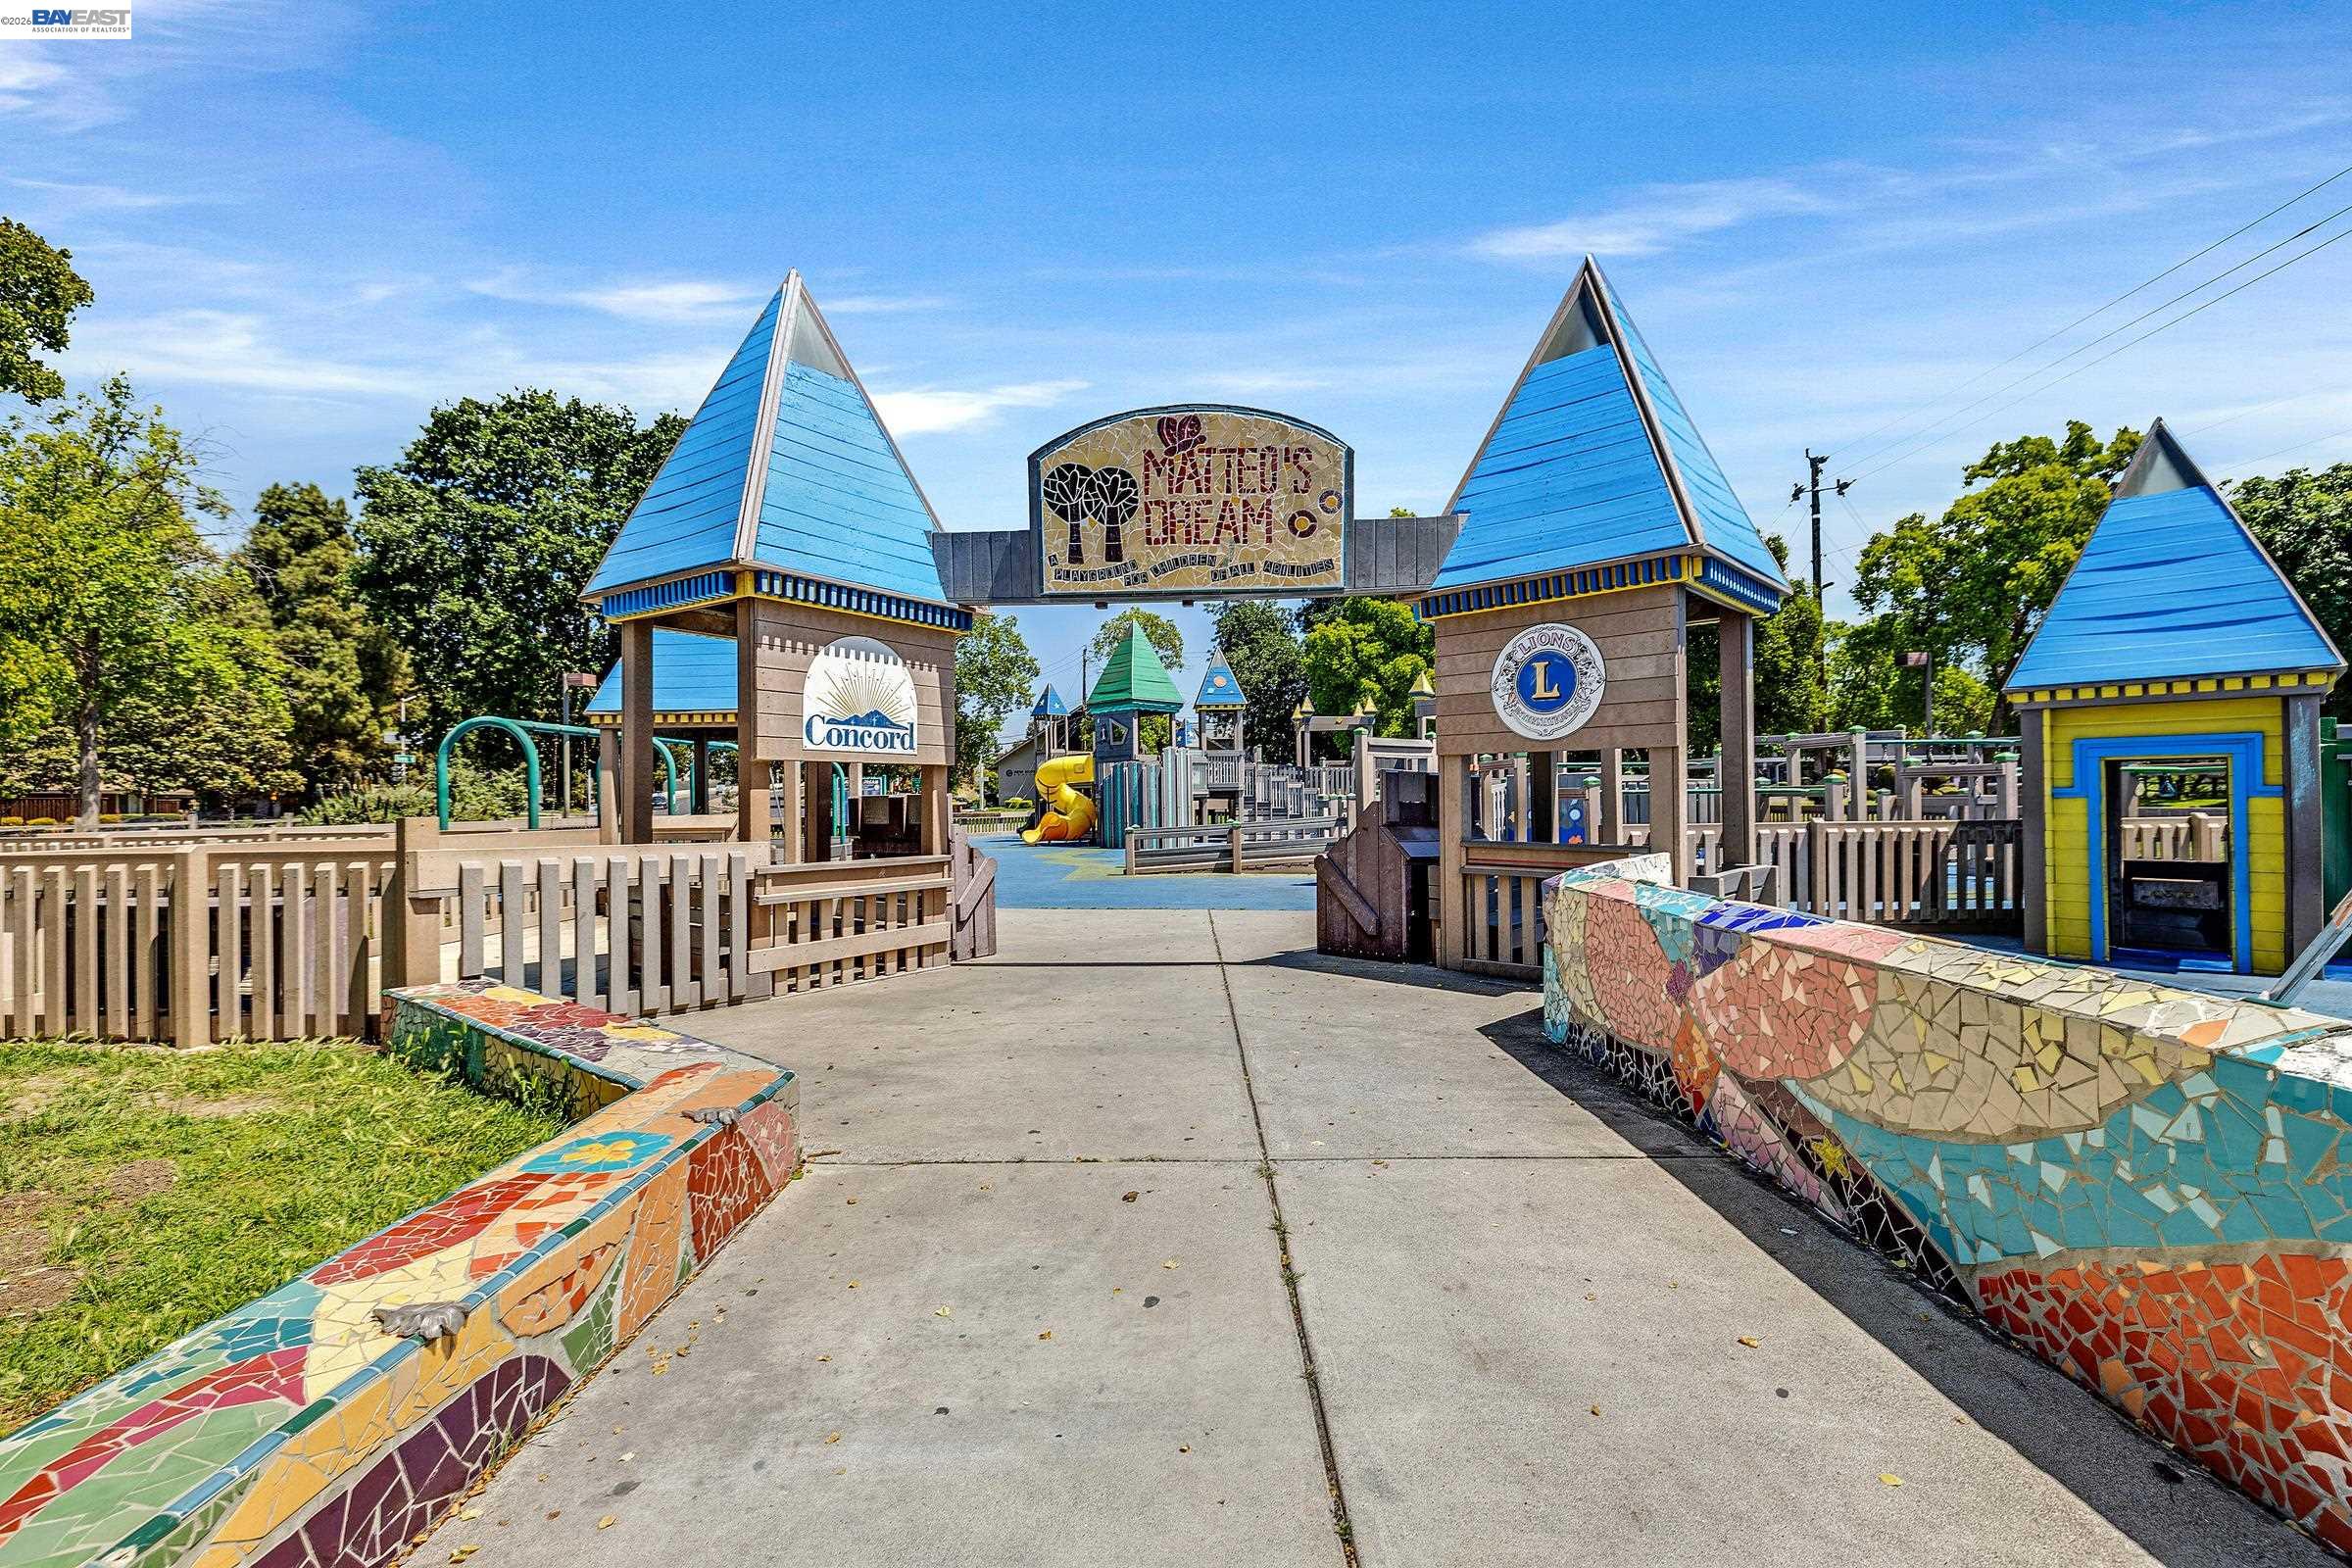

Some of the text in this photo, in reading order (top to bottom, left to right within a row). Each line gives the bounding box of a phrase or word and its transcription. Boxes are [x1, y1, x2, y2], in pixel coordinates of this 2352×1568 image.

[1143, 445, 1313, 496] MATTEO'S
[1144, 498, 1273, 545] DREAM
[1049, 554, 1334, 586] A PLAYGROUND FOR CHILDREN OF ALL ABILITIES
[1518, 631, 1577, 655] LIONS
[1532, 662, 1561, 699] L
[805, 713, 915, 750] Concord
